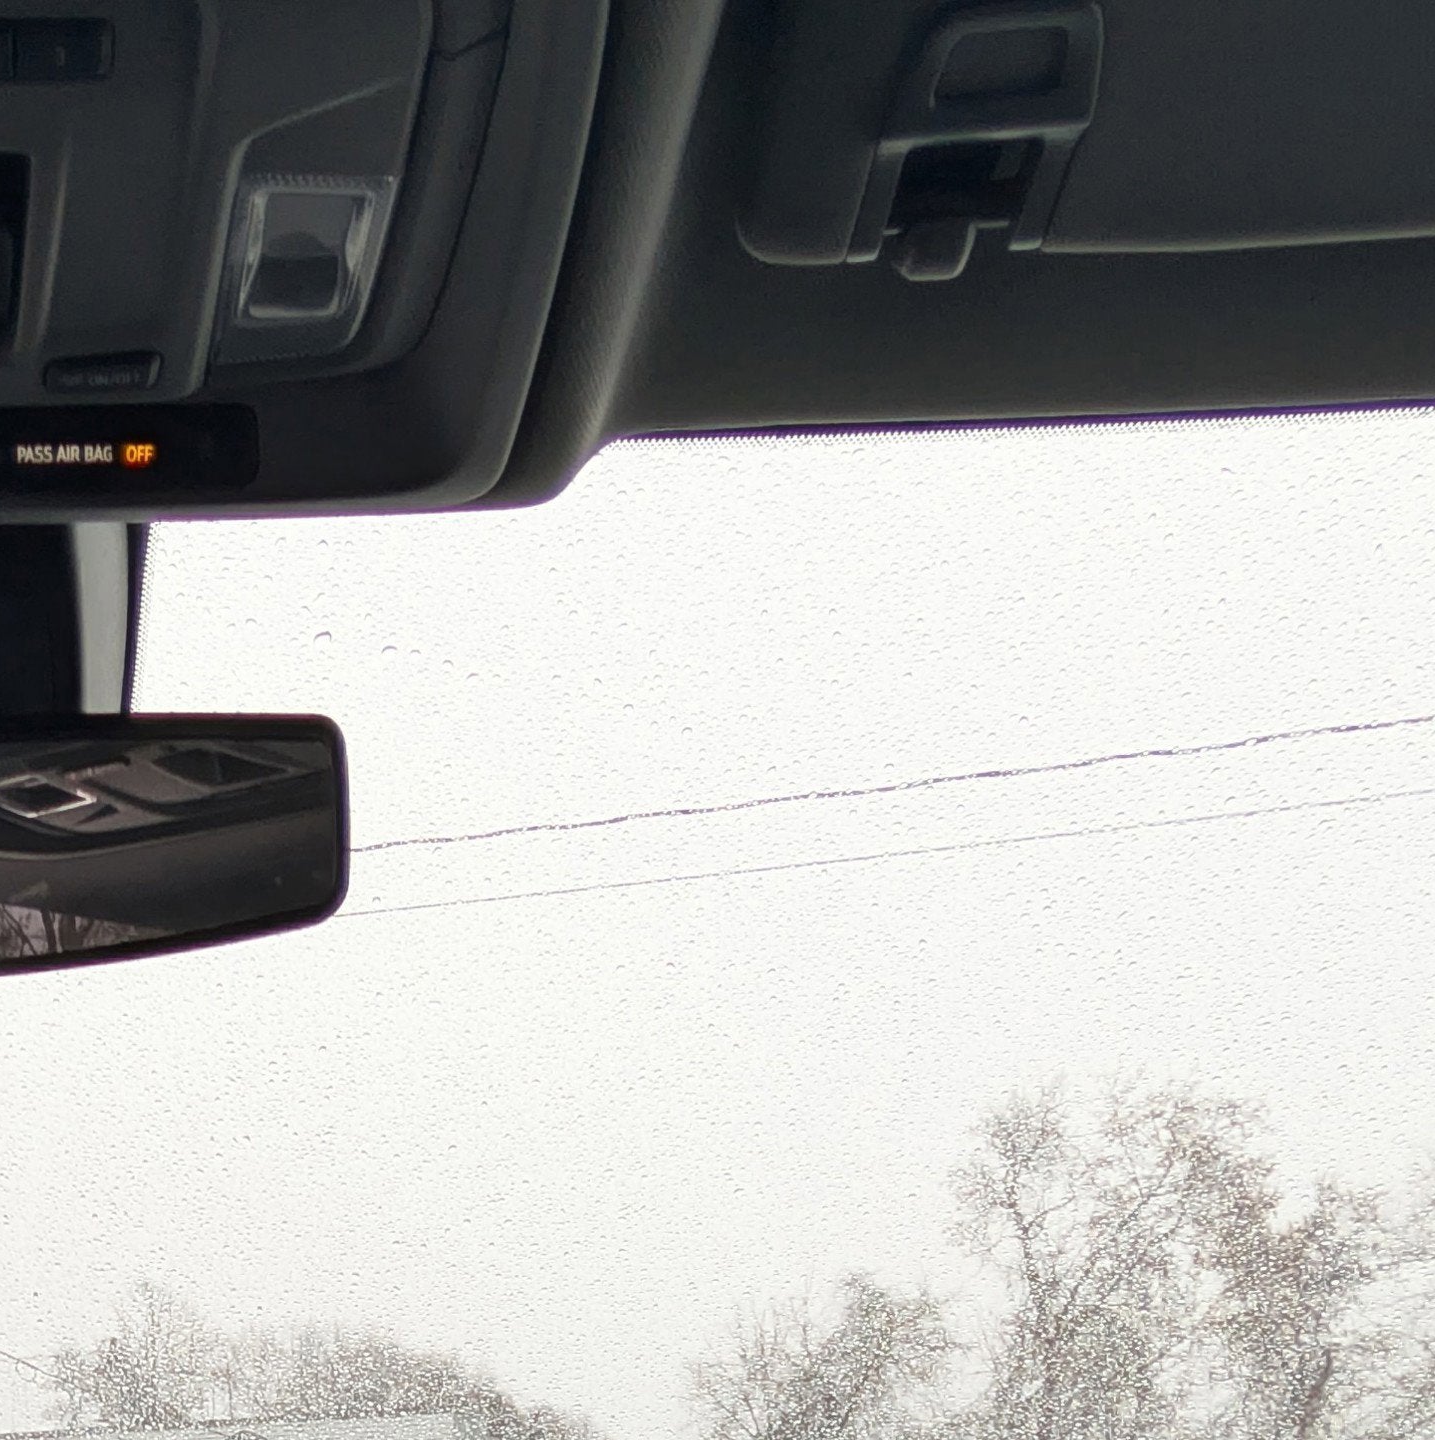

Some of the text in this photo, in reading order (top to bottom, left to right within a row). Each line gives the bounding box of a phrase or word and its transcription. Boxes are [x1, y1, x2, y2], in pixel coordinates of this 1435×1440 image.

[17, 445, 155, 463] PASS AIR BAG OFF
